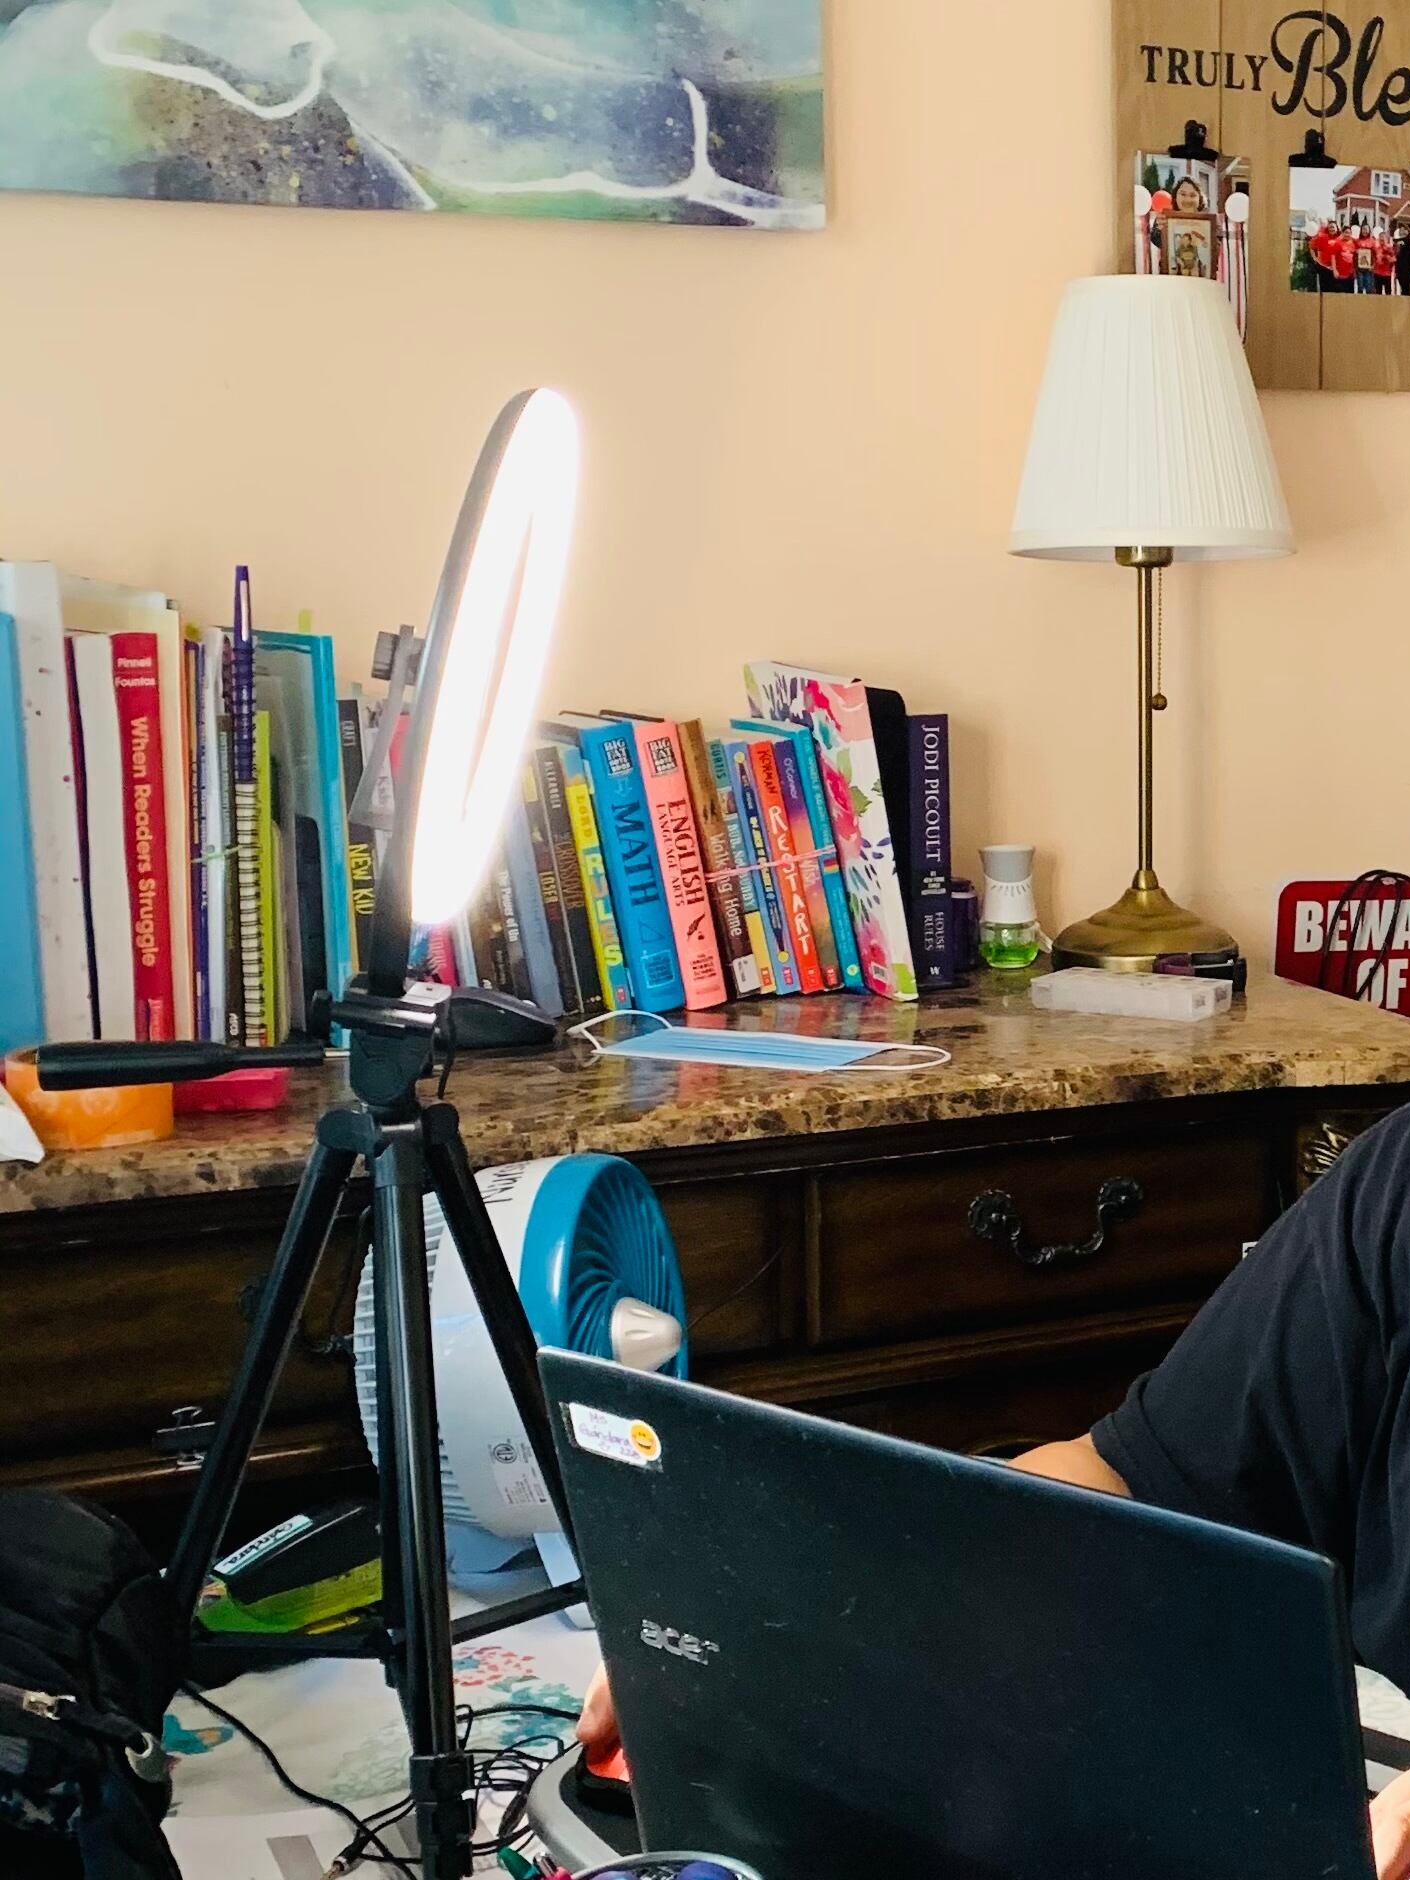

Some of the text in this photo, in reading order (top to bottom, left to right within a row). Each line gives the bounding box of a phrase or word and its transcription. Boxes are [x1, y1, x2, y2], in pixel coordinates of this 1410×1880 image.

[1140, 44, 1268, 91] TRULY
[115, 676, 156, 688] Fountas
[711, 744, 727, 779] CURTIS
[922, 724, 941, 770] JODI
[758, 750, 778, 794] KORMAN
[576, 795, 593, 839] LORD
[924, 778, 941, 862] PICOULT
[130, 716, 159, 967] When Readers Struggle
[612, 800, 660, 907] MATH
[656, 803, 685, 907] LANGUAGE ARTS
[668, 799, 706, 905] ENGLISH
[348, 842, 375, 916] NEW KID
[555, 839, 585, 910] CROSSOVER
[710, 832, 742, 937] Walkng Home
[501, 886, 516, 916] Power
[505, 917, 518, 929] of
[924, 914, 934, 952] RULES
[935, 911, 945, 952] HOUSE
[1356, 958, 1409, 1010] OF
[640, 1619, 720, 1666] acer
